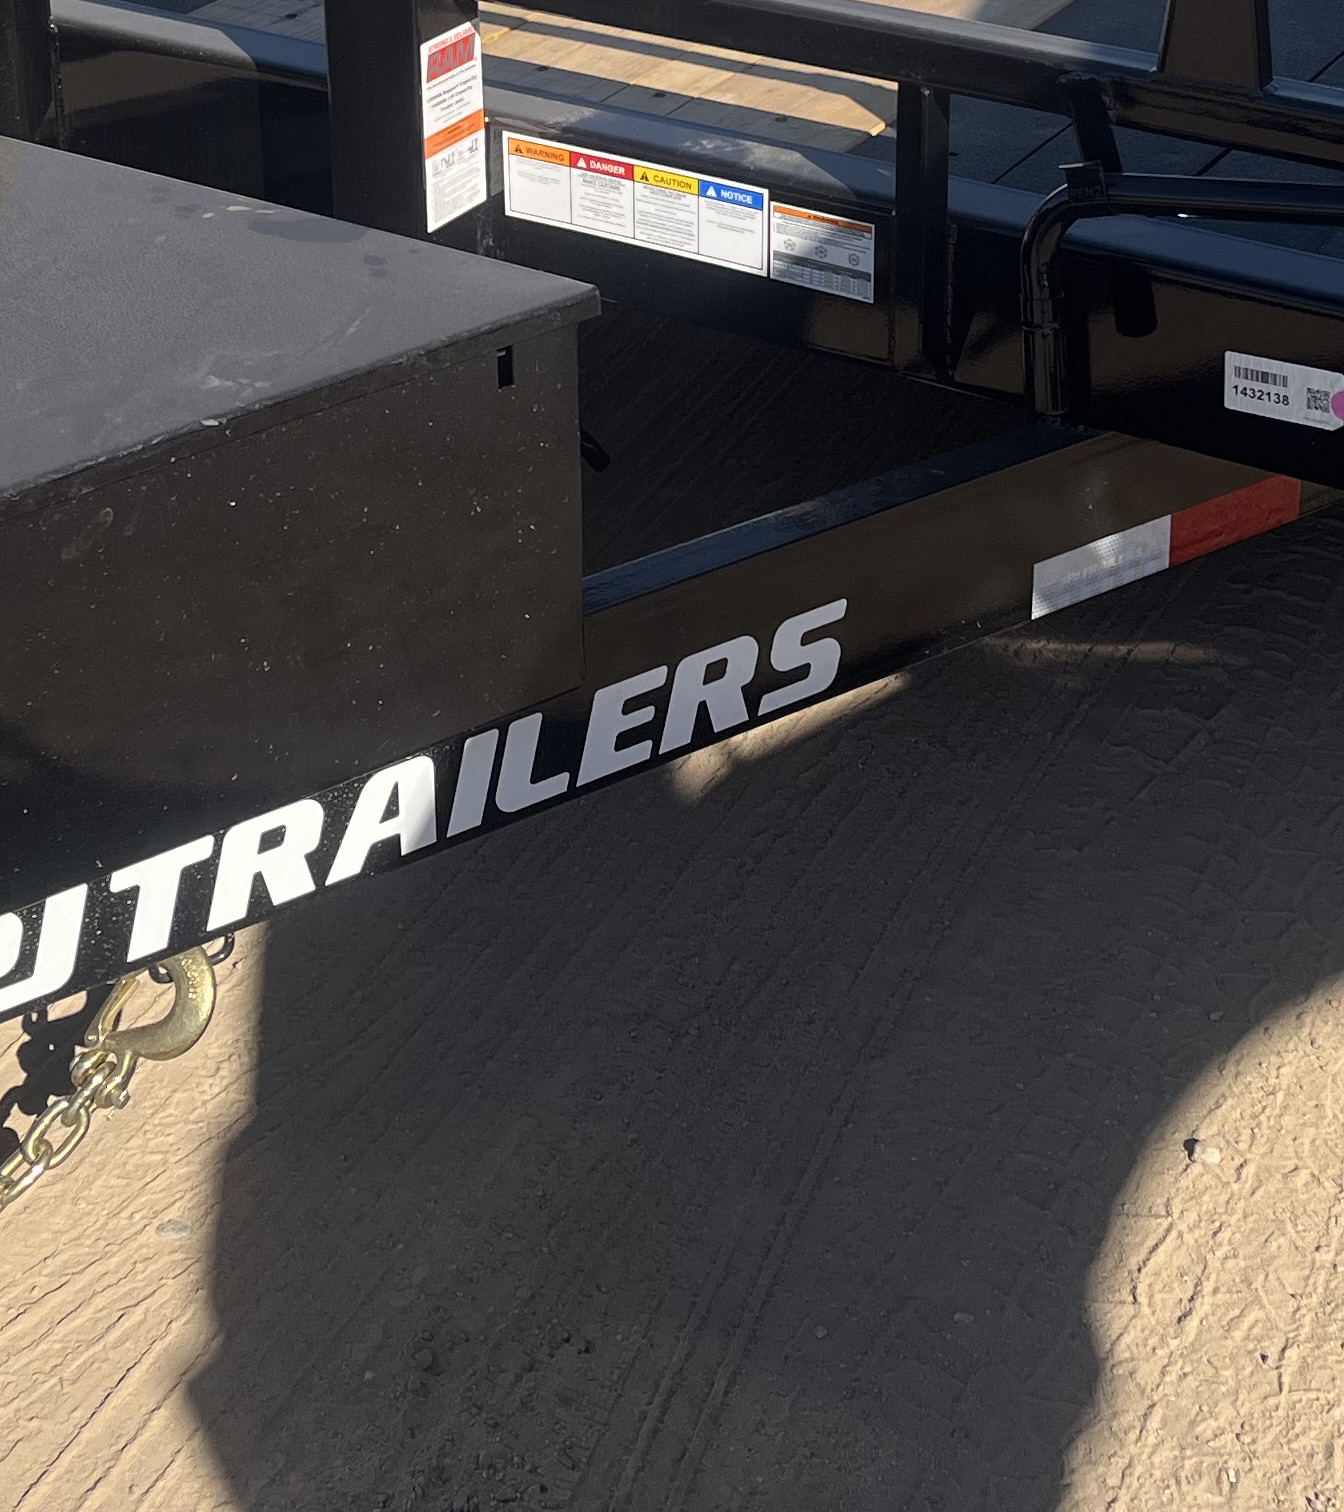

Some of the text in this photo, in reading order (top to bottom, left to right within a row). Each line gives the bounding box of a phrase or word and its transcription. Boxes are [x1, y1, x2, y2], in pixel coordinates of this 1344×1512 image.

[525, 146, 565, 162] WARNING
[589, 160, 626, 176] DANGER
[653, 174, 692, 190] CAUTION
[720, 189, 753, 205] NOTICE
[1231, 383, 1290, 407] 1432138
[109, 598, 847, 963] TRAILERS
